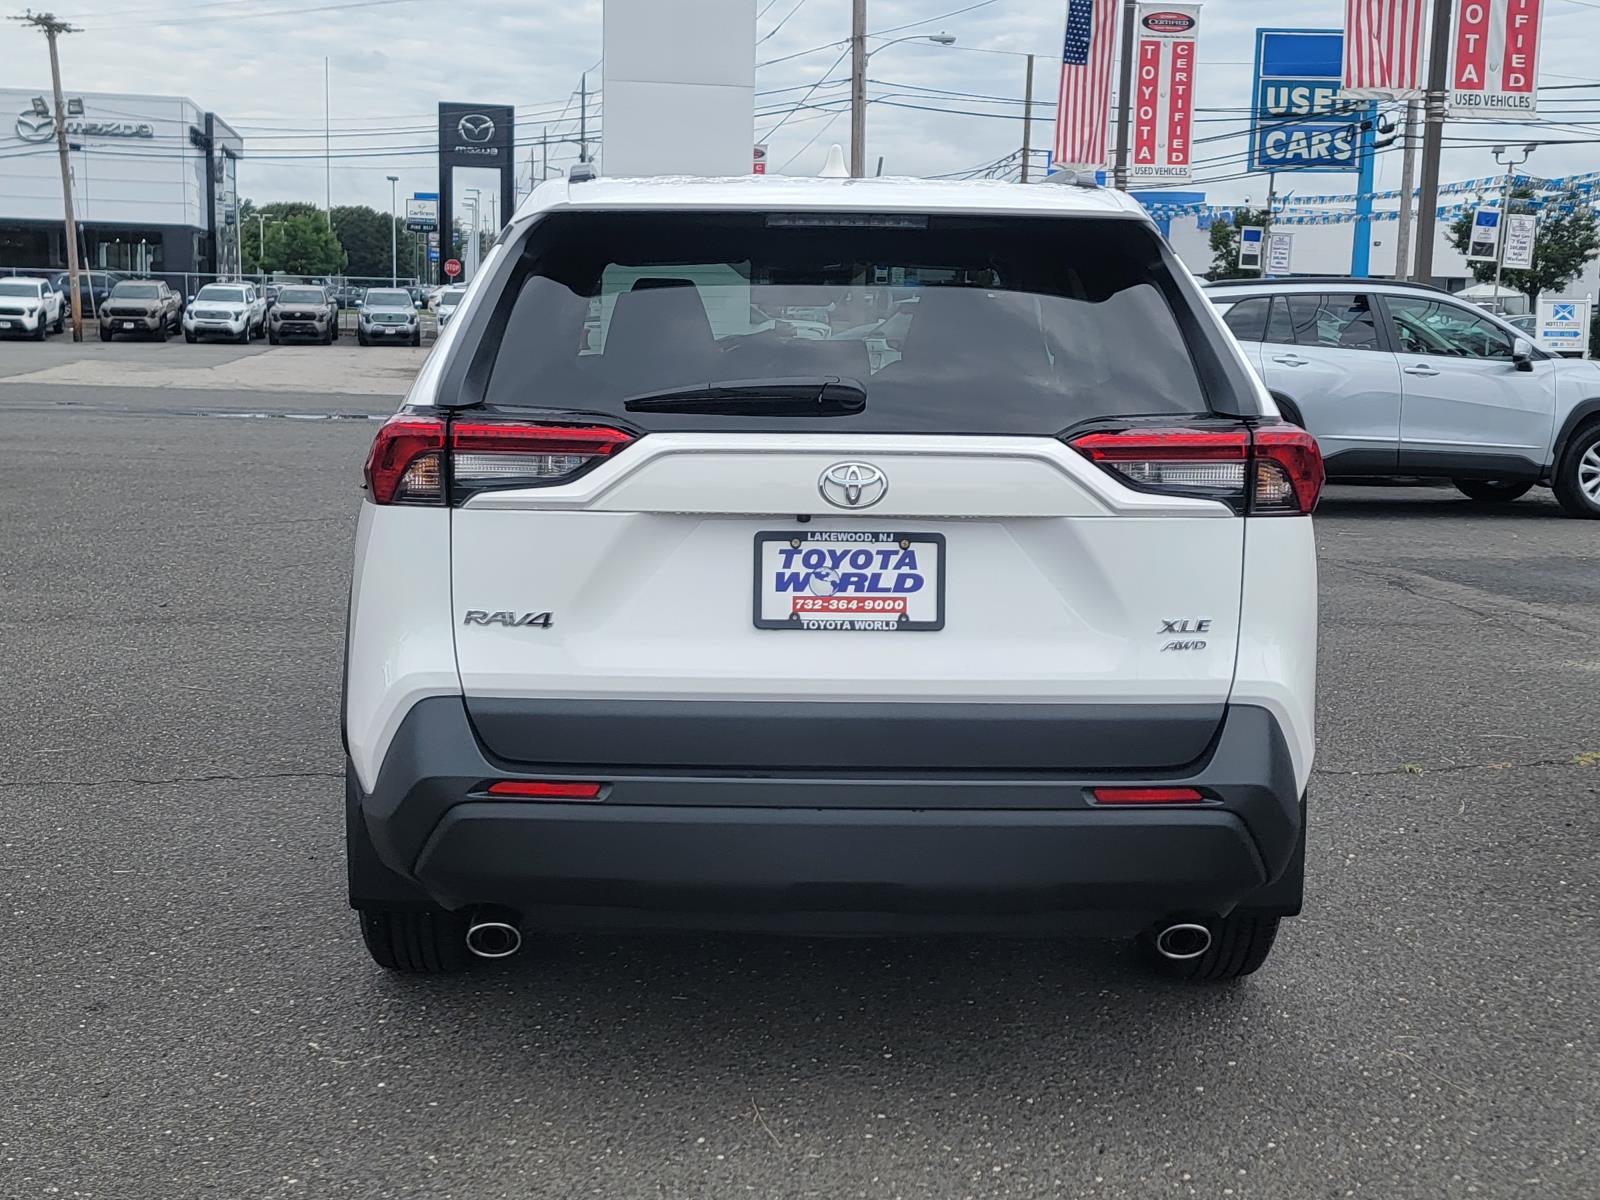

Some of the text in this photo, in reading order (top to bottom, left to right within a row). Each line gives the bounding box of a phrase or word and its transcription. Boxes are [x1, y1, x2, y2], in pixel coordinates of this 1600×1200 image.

[1138, 45, 1155, 160] TOYOTA
[1171, 45, 1189, 162] CERTIFIED
[1455, 93, 1531, 108] USED VEHICLES
[1265, 130, 1352, 160] CARS
[1135, 166, 1188, 176] USED VEHICLES
[446, 263, 460, 271] STOP
[807, 532, 894, 544] LAKEWOOD, NJ
[778, 548, 918, 570] TOYOTA
[775, 570, 925, 595] WORLD
[795, 599, 904, 610] 732-364-9000
[463, 610, 554, 629] RAV4
[801, 620, 898, 631] TOYOTA WORLD
[1156, 619, 1212, 634] XLE
[1160, 640, 1207, 652] AWD
